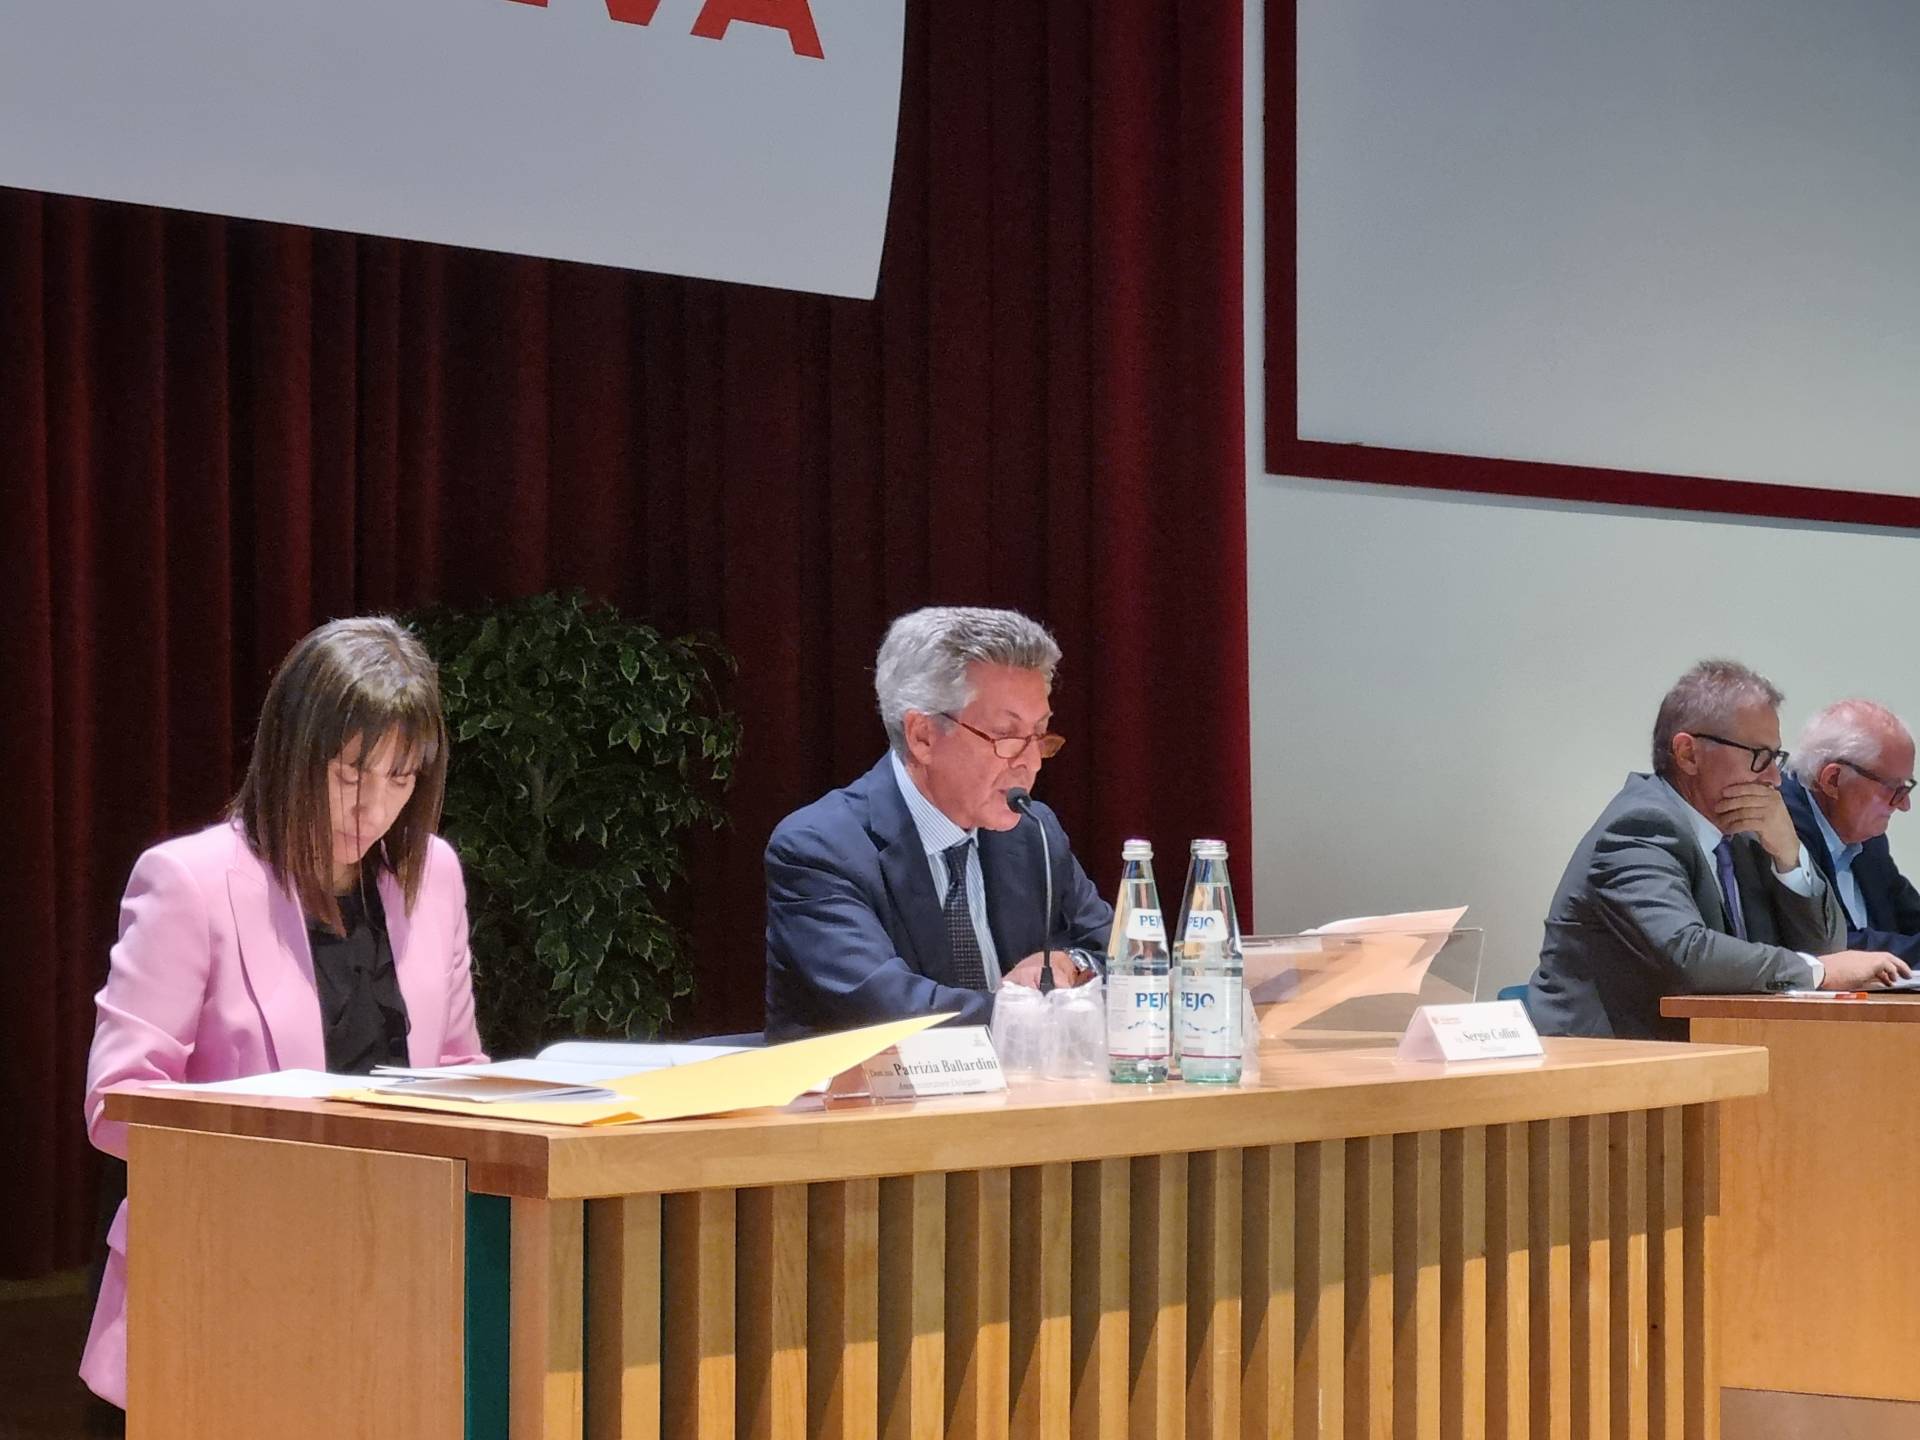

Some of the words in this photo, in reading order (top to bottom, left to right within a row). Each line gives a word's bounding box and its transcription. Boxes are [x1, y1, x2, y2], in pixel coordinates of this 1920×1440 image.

[1462, 1029, 1491, 1042] Sergio
[893, 1061, 940, 1076] Patrizia
[941, 1057, 998, 1073] Ballardini
